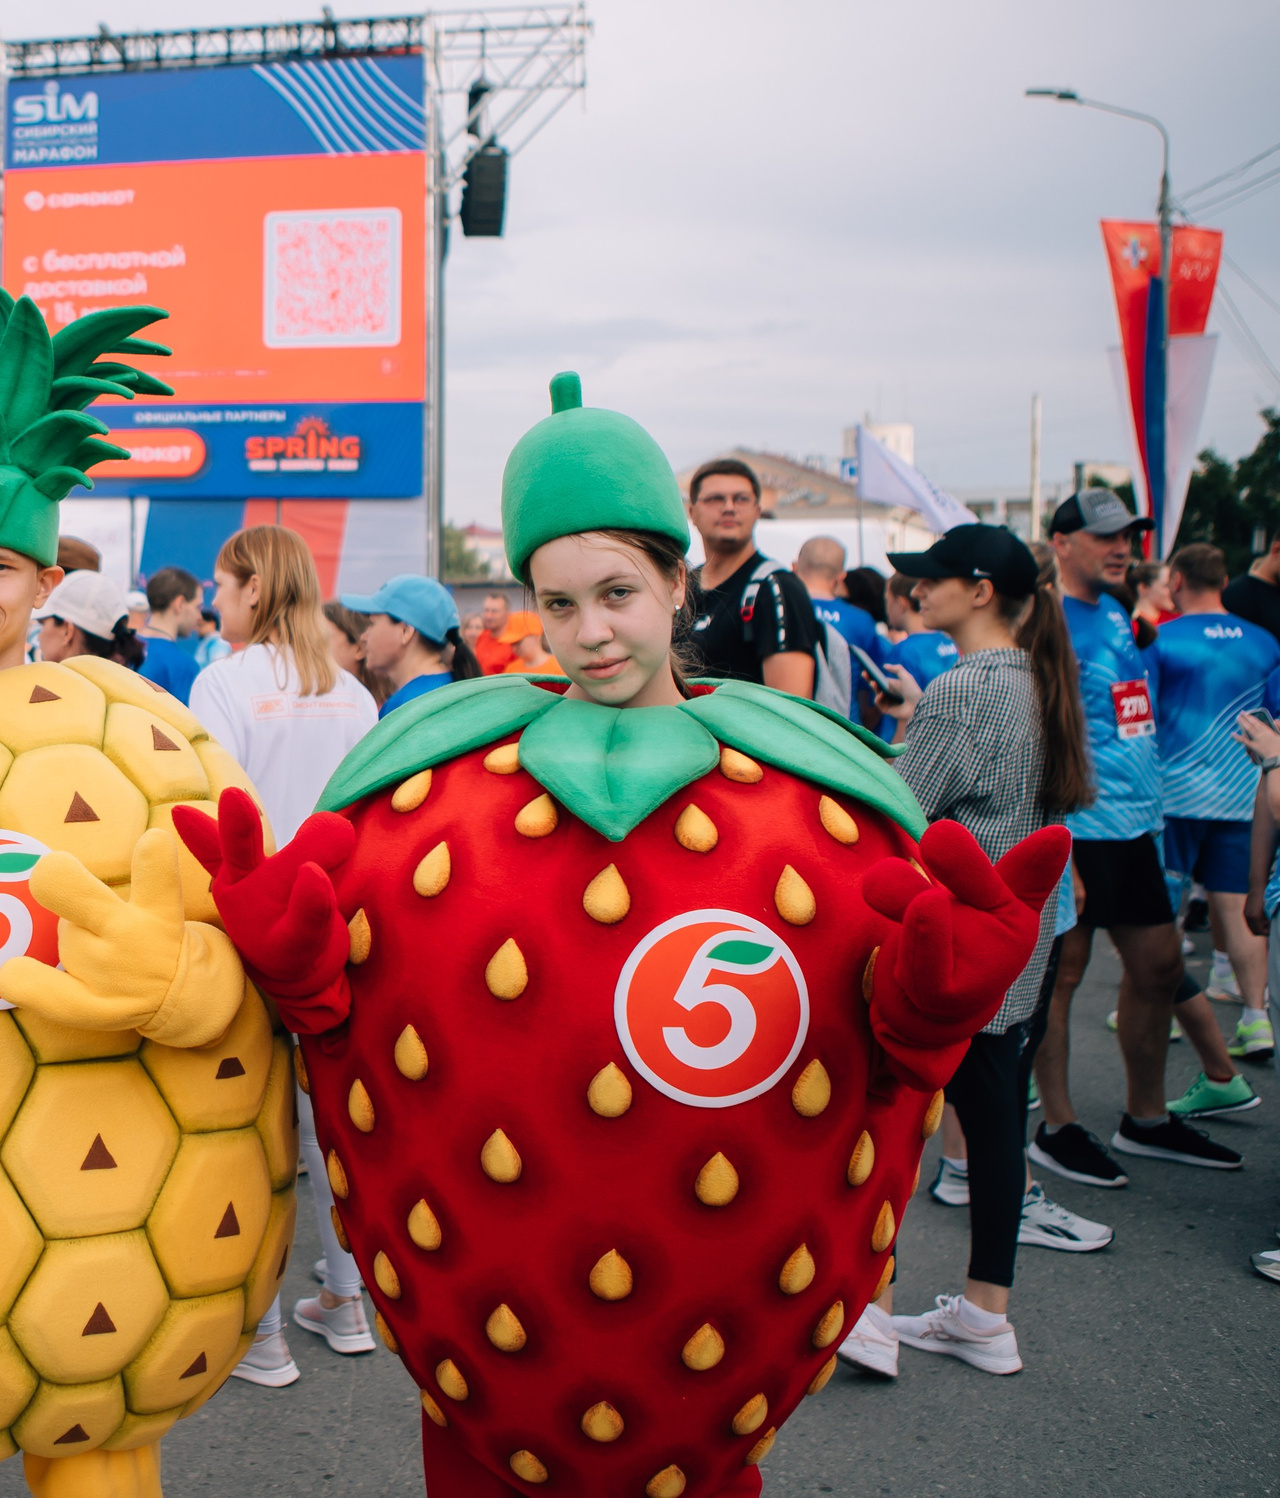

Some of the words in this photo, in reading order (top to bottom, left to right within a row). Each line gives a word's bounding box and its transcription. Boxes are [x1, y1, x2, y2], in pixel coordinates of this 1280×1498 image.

[13, 121, 98, 139] СИБИРСКИЙ
[13, 145, 98, 164] МАРАФОН
[22, 255, 39, 274] с
[42, 244, 186, 272] бесплатной
[23, 271, 148, 300] доставкой
[134, 411, 222, 424] ОФИЦИАЛЬНЫЕ
[224, 410, 287, 422] ПАРТНЕРЫ
[245, 429, 360, 460] SPRING
[662, 930, 781, 1070] 5
